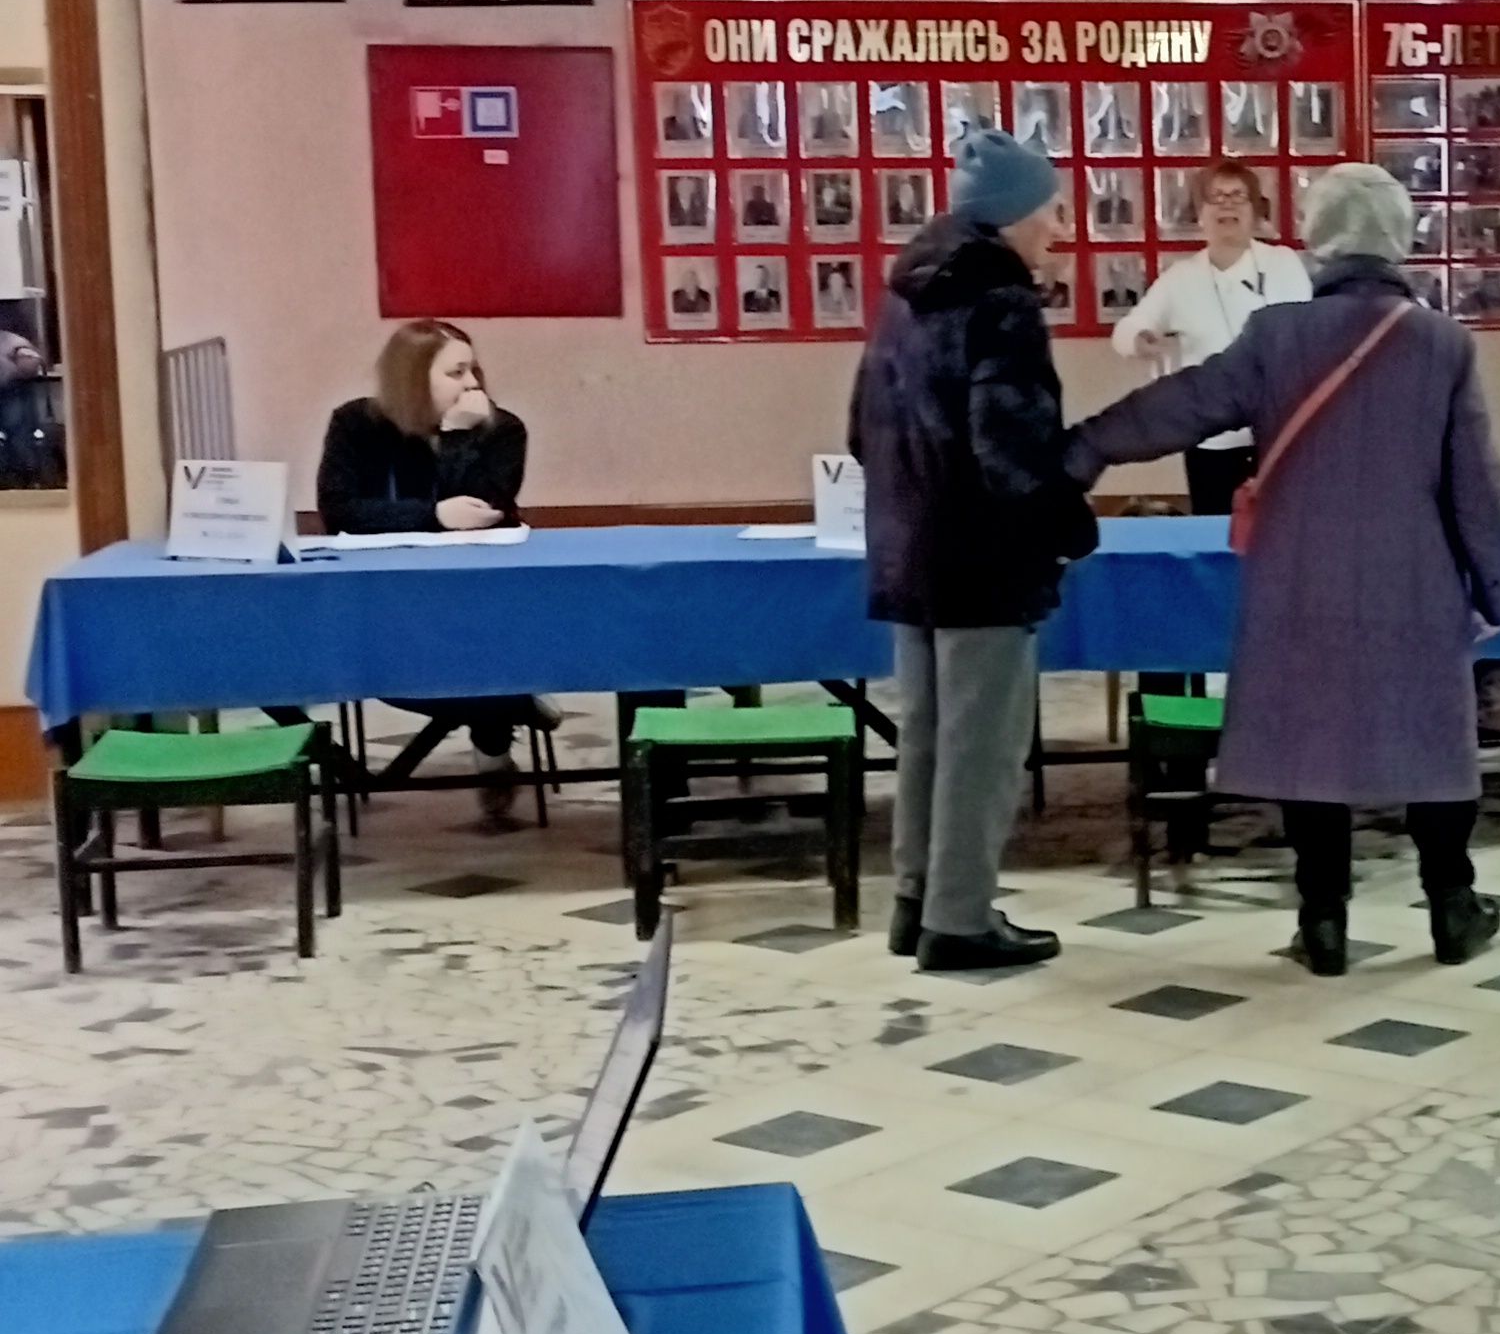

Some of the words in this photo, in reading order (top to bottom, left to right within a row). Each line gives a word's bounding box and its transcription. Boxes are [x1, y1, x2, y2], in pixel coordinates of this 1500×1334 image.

[704, 18, 777, 63] ОНИ
[787, 18, 1010, 63] СРАЖАЛИСЬ
[1021, 20, 1067, 64] ЗА
[1075, 20, 1213, 68] РОДИНУ
